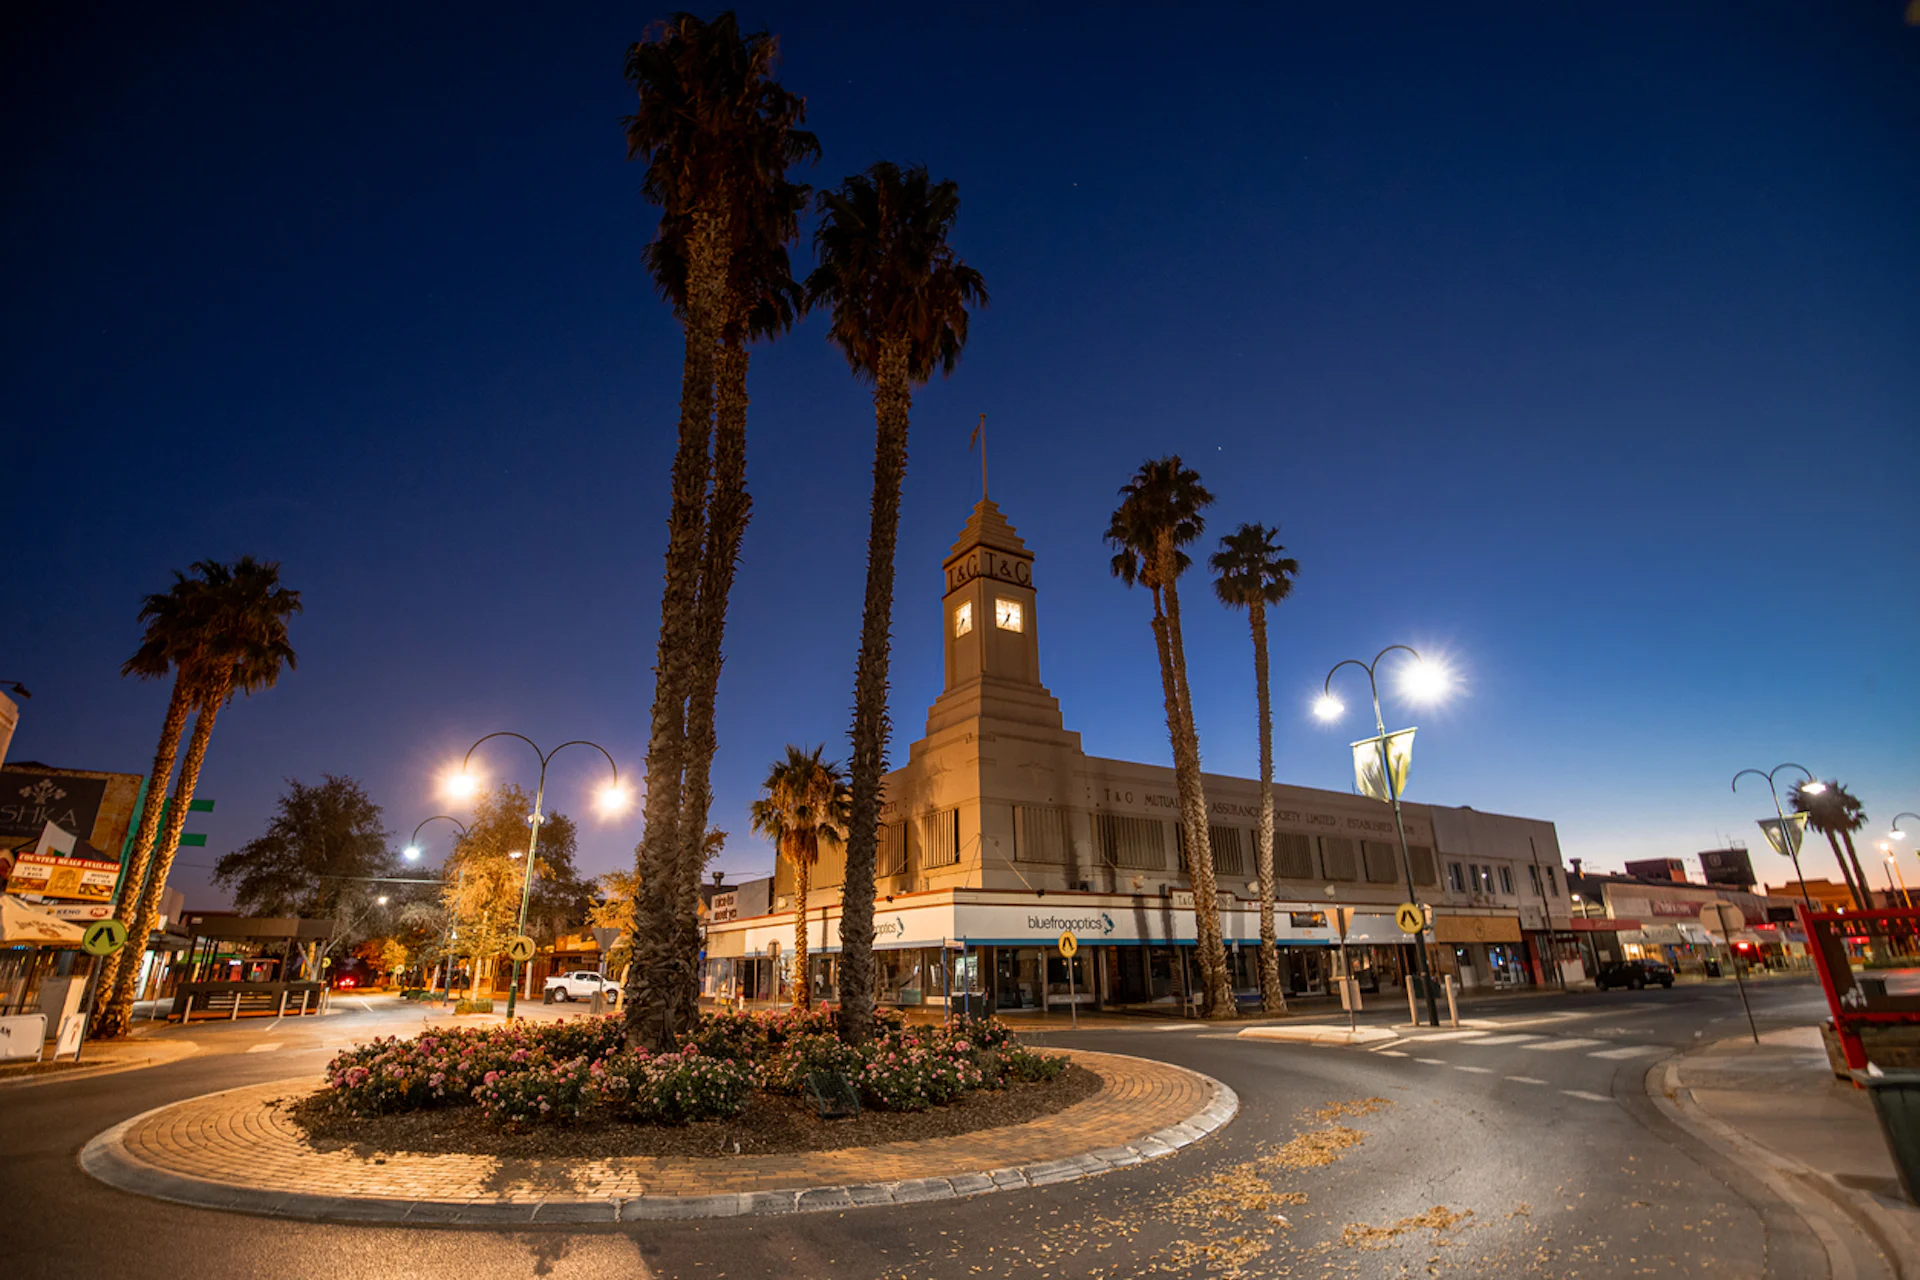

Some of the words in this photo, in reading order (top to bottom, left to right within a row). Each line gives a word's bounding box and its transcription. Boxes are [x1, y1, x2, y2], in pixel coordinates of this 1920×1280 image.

[1144, 793, 1181, 809] MUTUAL
[1272, 807, 1300, 823] OCIETY
[1305, 811, 1335, 826] LIMITED
[1028, 915, 1102, 932] bluefrogoptics
